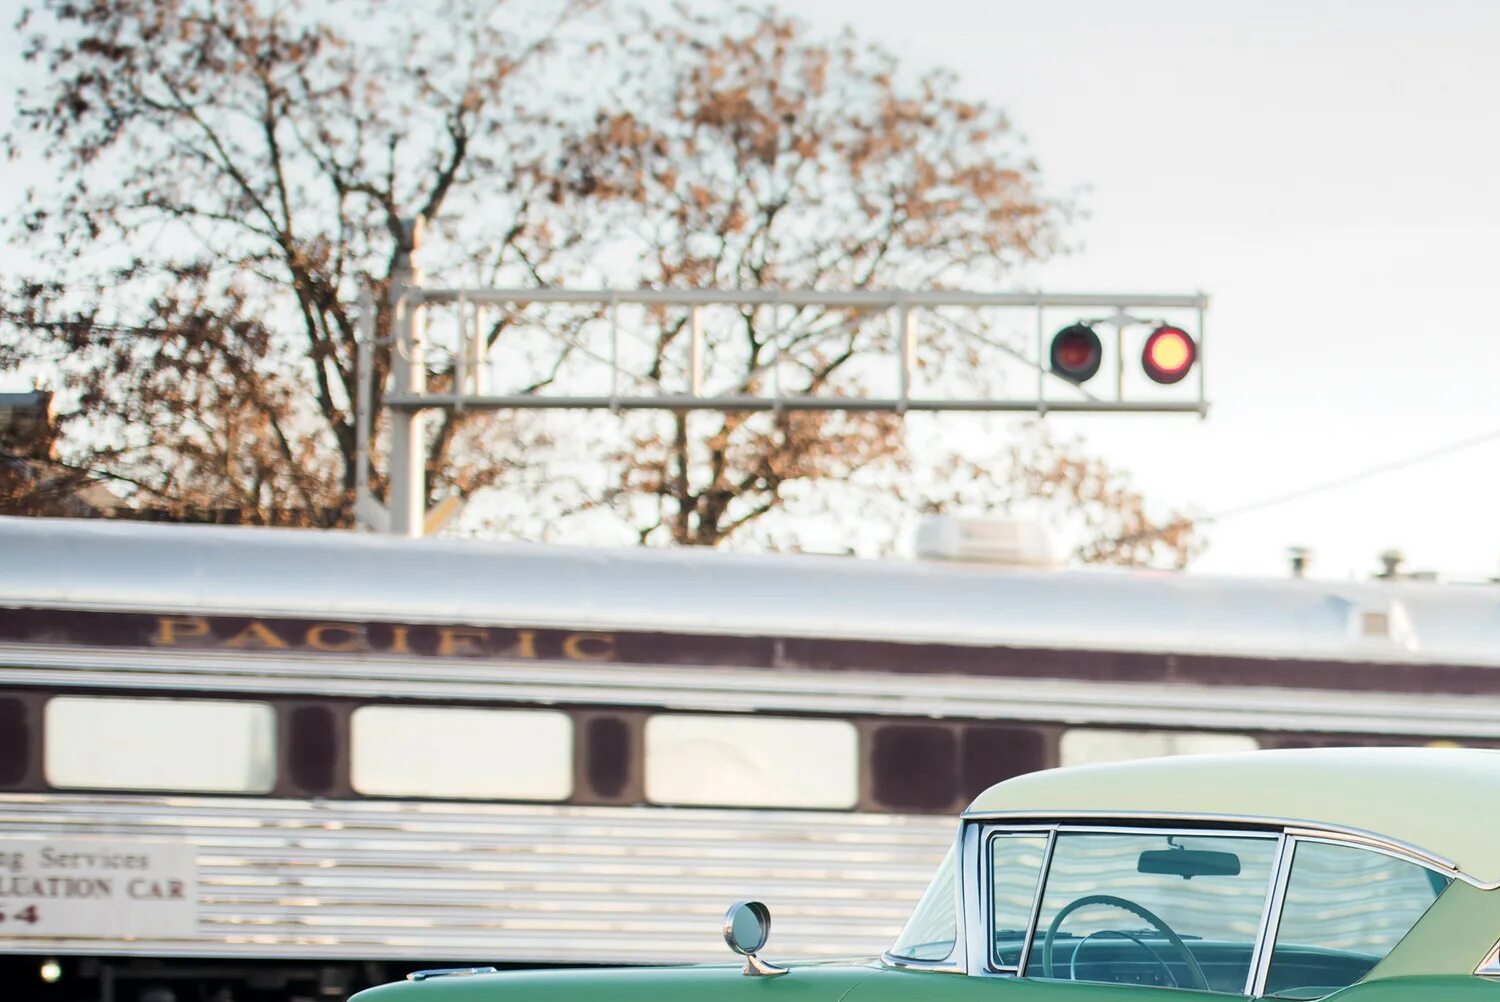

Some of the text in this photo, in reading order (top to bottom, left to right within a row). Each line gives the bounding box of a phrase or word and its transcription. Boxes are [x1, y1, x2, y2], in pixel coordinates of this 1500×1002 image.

[153, 614, 618, 662] PACIFIC
[39, 847, 150, 870] Services
[127, 879, 187, 899] CAR
